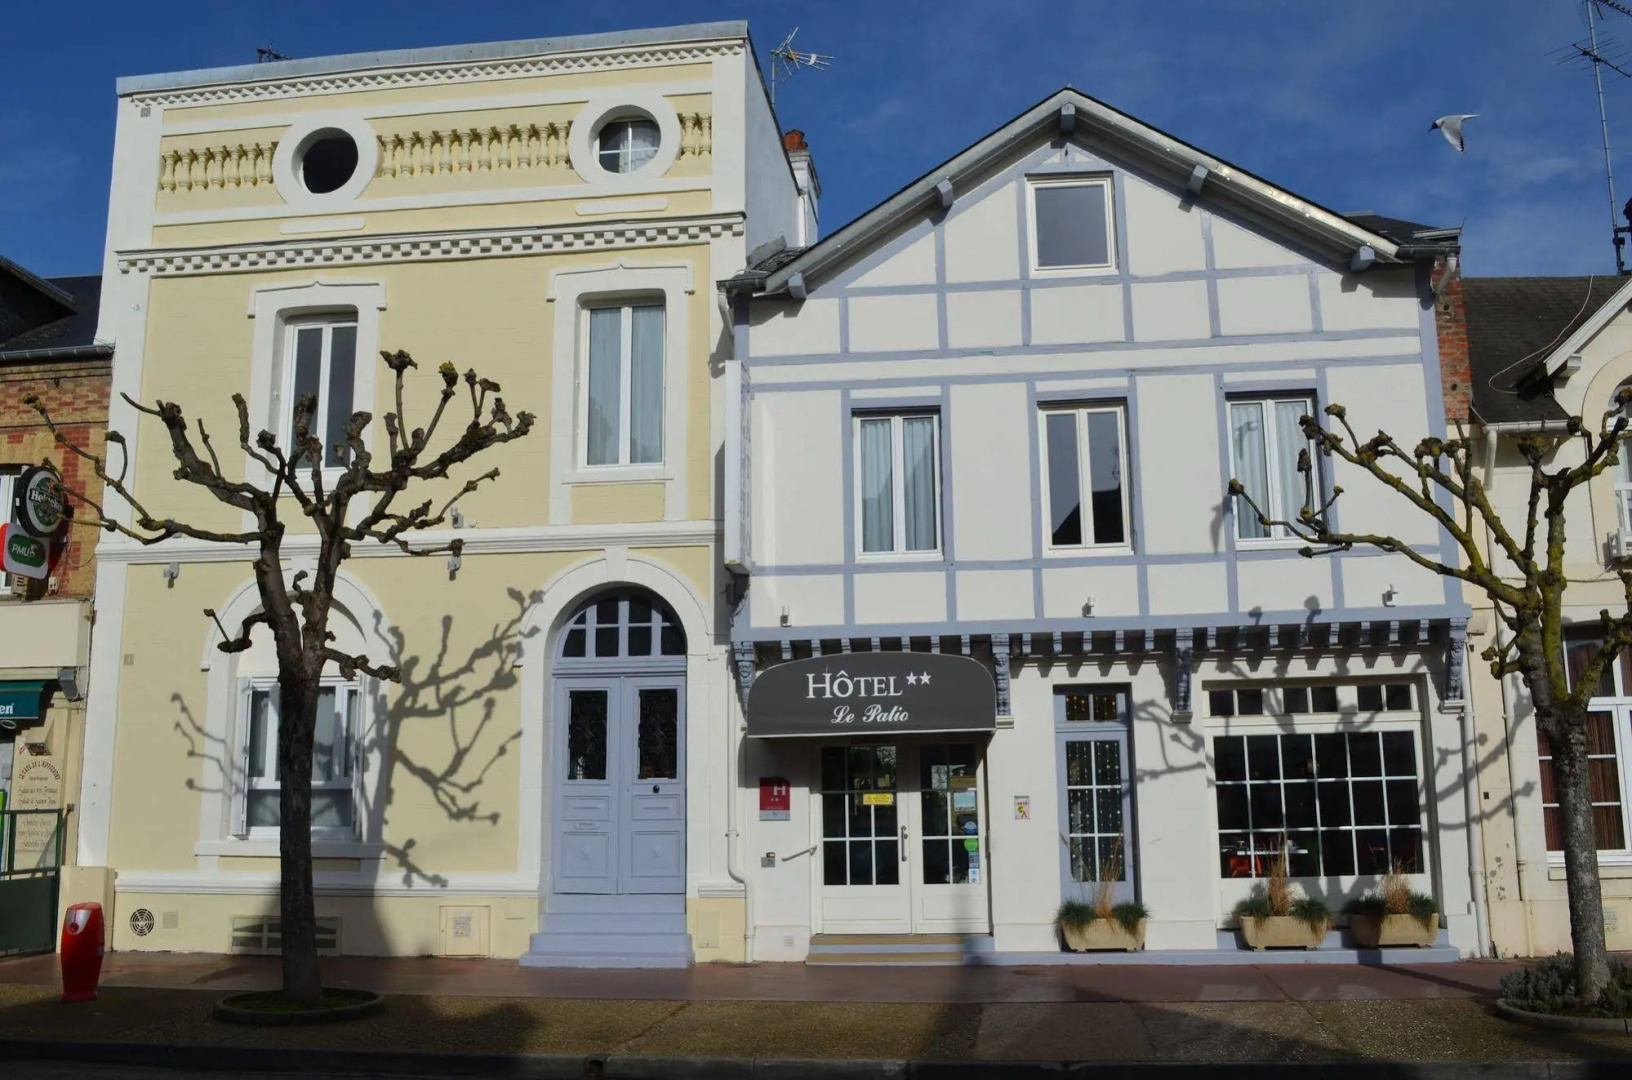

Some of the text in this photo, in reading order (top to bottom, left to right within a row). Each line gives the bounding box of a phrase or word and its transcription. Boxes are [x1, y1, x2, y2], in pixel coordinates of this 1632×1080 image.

[12, 543, 31, 557] PMU
[806, 670, 903, 698] HÔTEL
[831, 704, 909, 724] Le Patio
[773, 785, 786, 796] H
